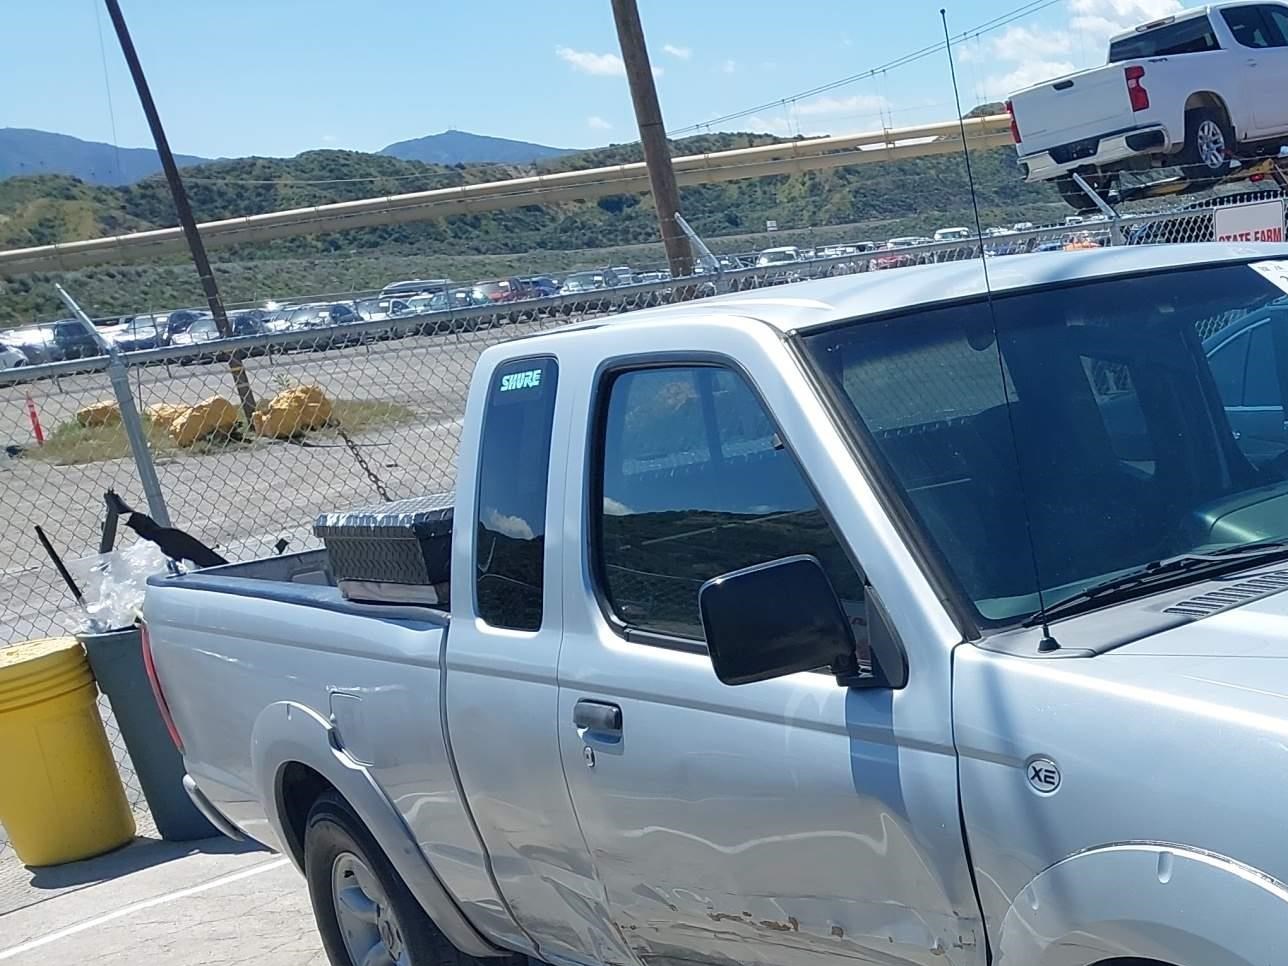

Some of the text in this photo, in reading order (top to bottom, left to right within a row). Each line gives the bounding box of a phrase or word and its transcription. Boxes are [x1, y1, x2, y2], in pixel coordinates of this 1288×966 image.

[1254, 227, 1282, 242] FARM
[500, 369, 541, 392] SHURE
[1030, 765, 1057, 786] XE
